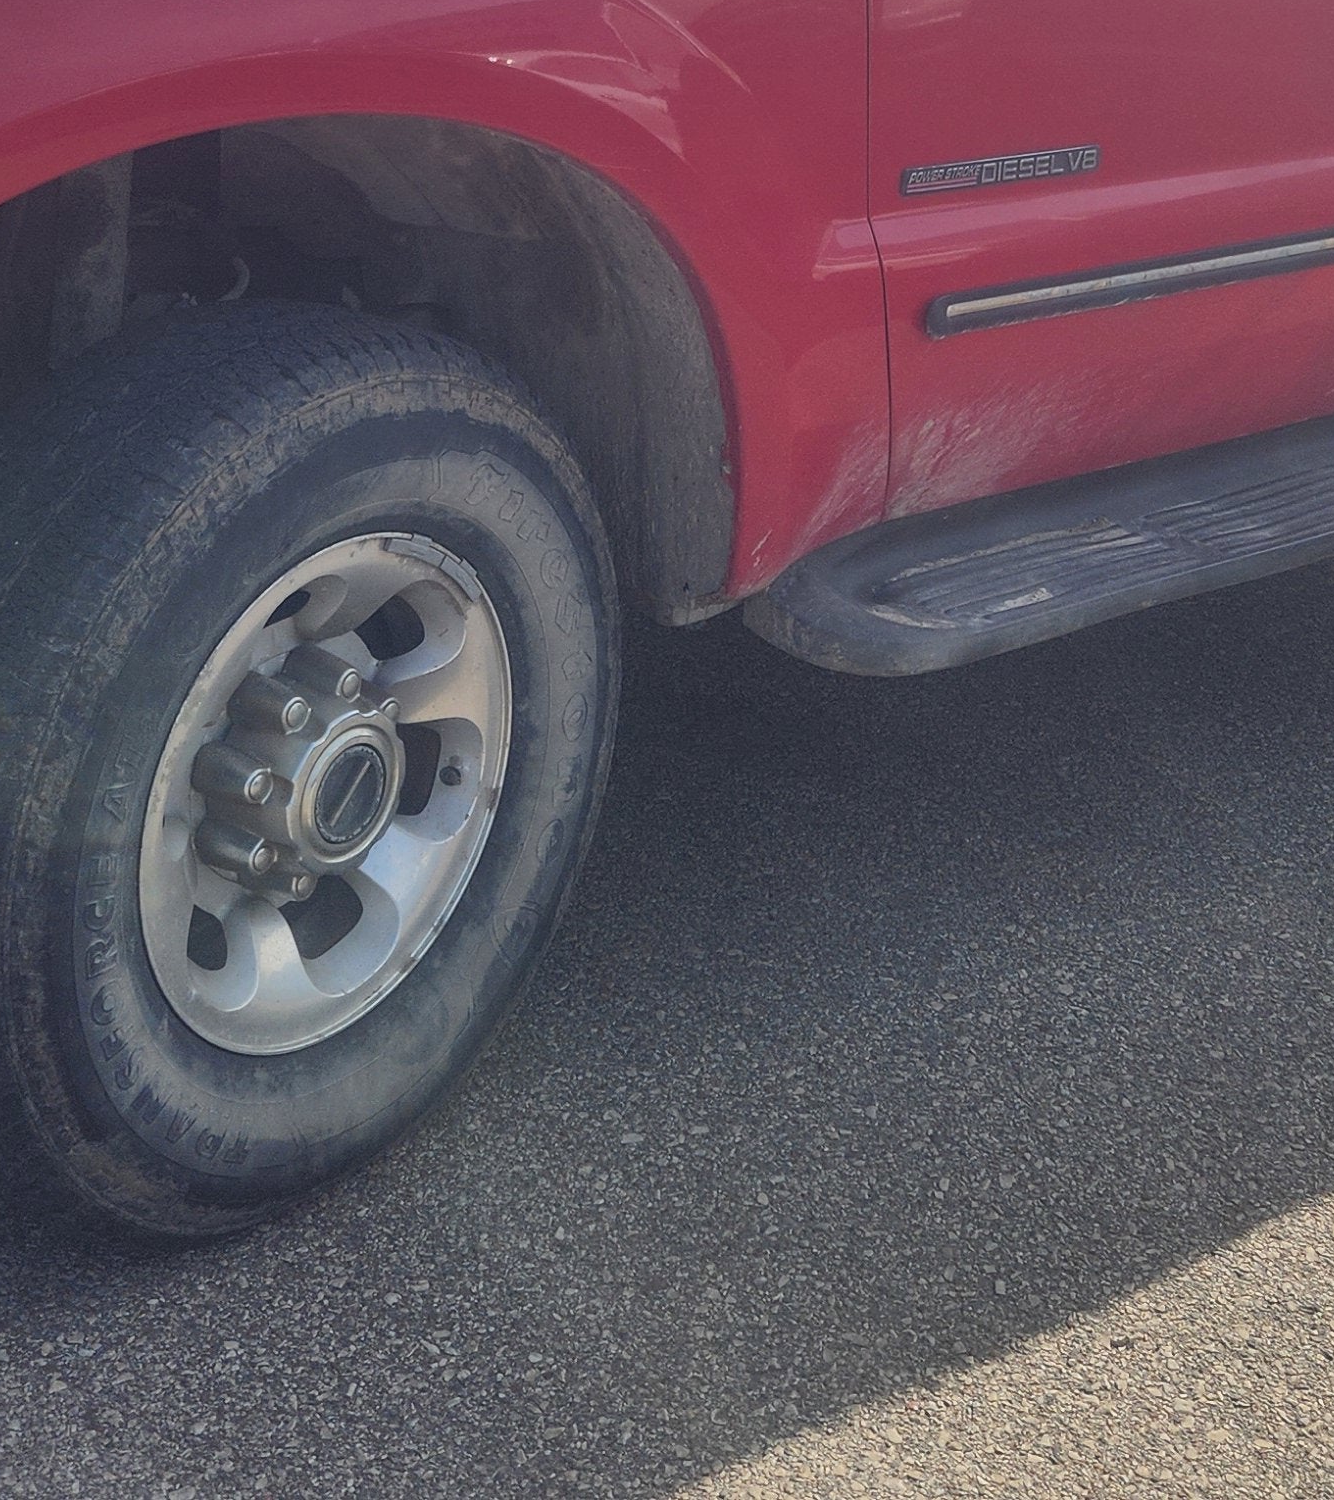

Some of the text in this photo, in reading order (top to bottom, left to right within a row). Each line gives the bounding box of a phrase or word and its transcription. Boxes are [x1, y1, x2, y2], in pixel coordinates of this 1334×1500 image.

[908, 149, 1098, 184] POWER STROKE DIESEL V8
